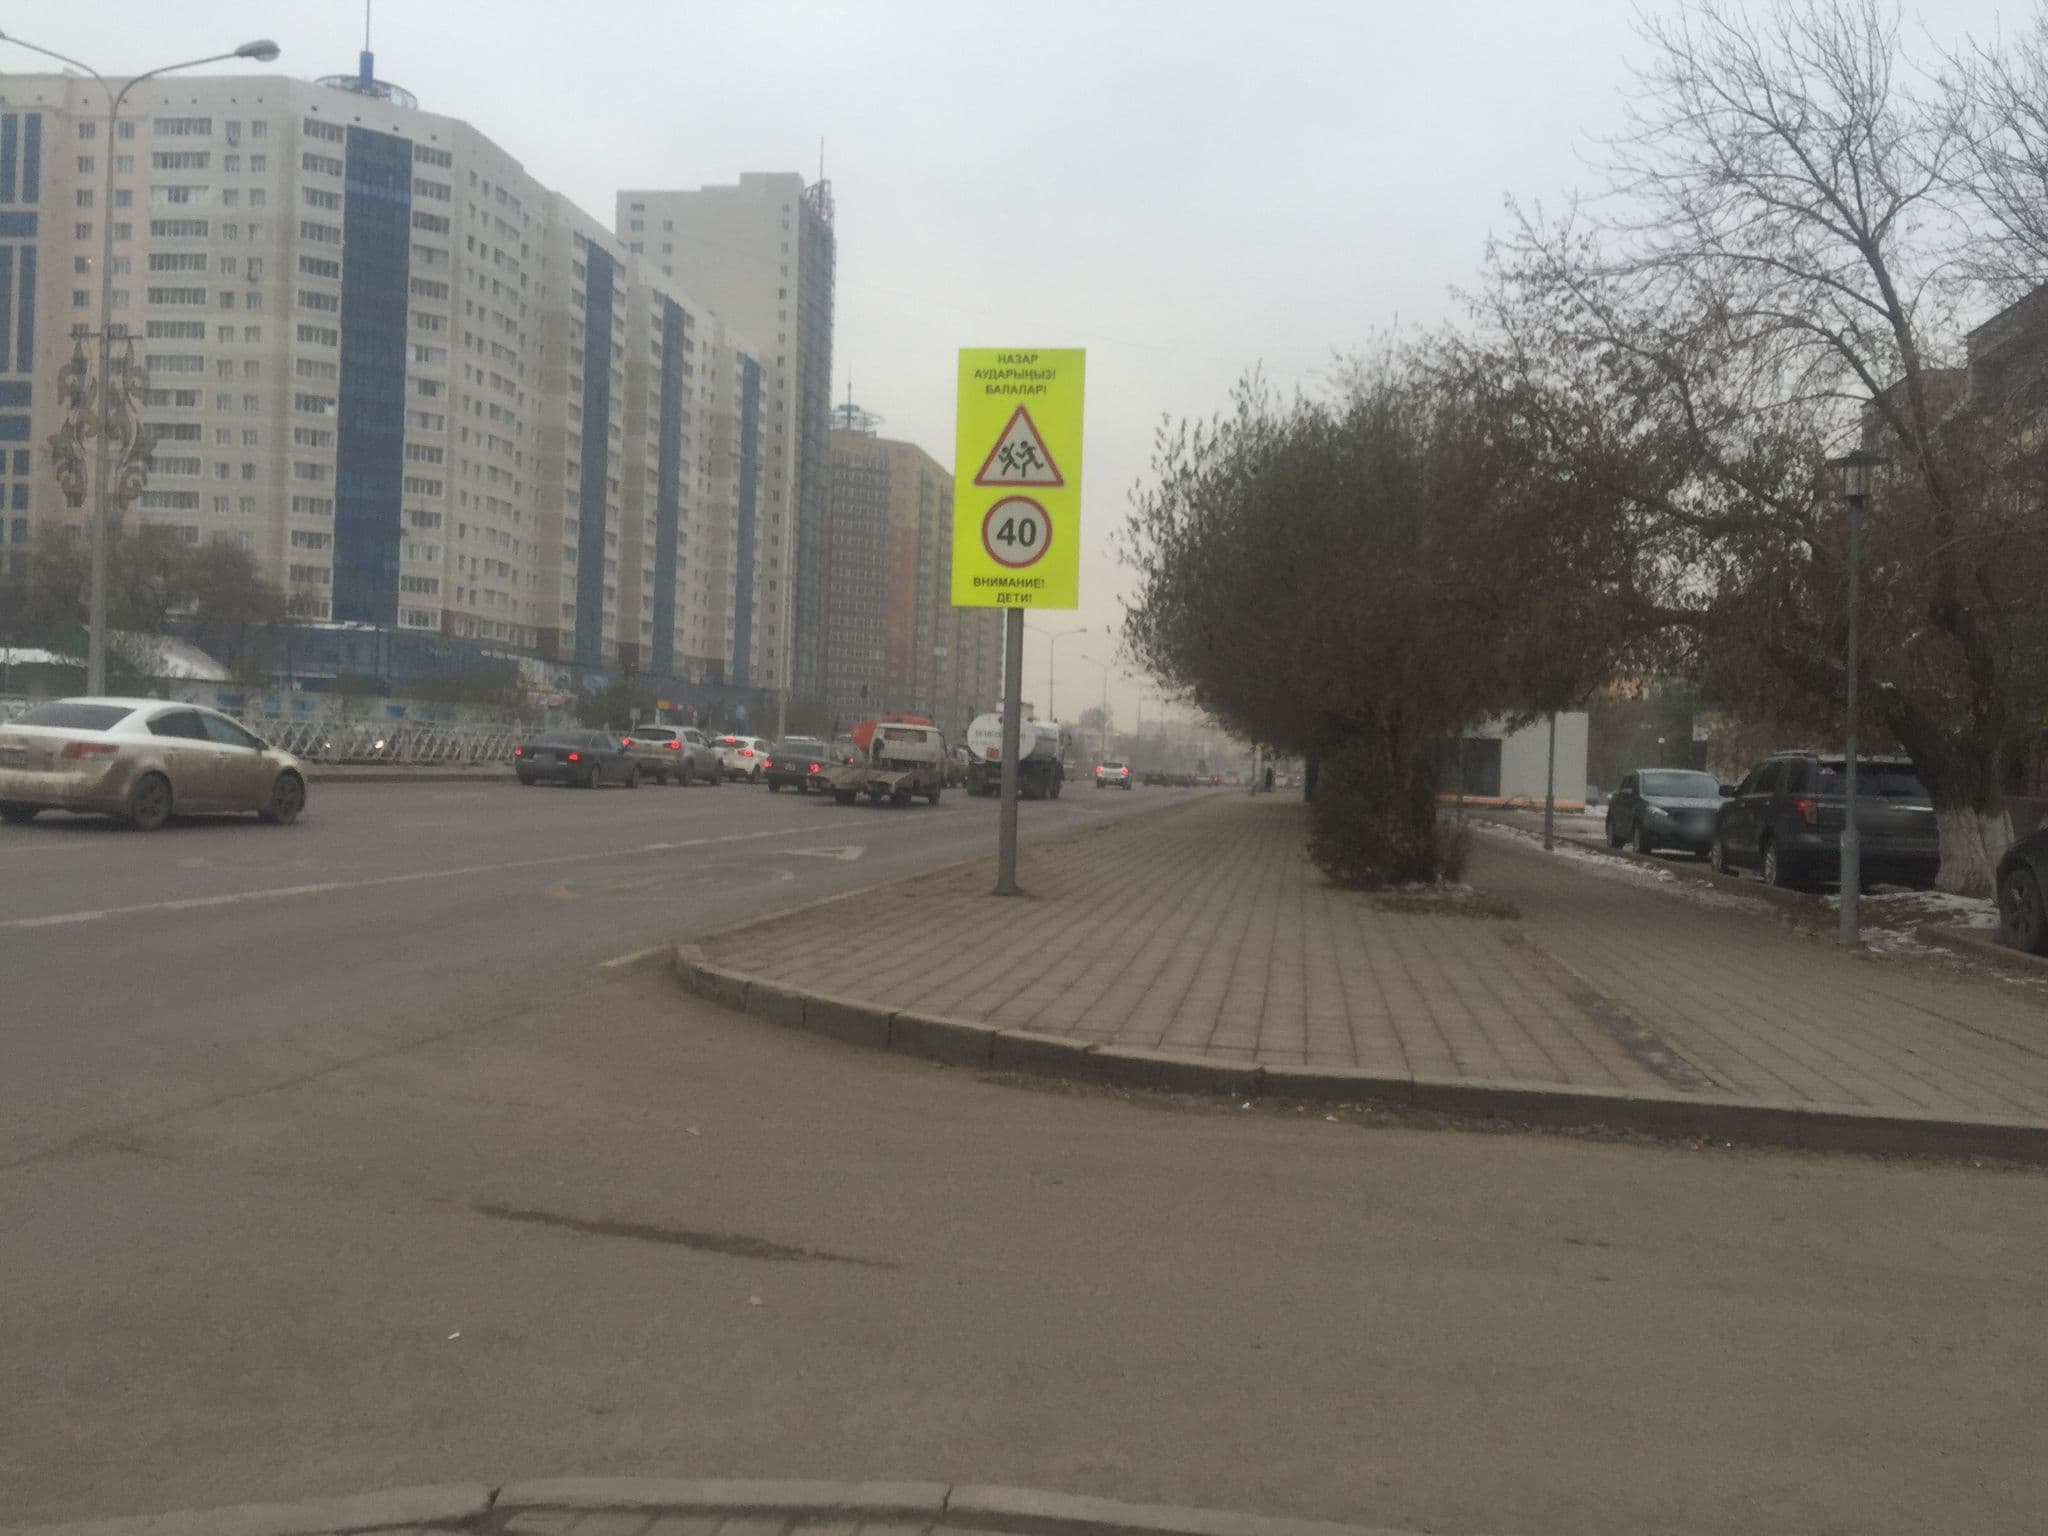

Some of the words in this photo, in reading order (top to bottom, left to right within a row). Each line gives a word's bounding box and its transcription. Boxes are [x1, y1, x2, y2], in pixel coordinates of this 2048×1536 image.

[998, 353, 1039, 364] НАЗАР
[985, 384, 1047, 395] БАЛАЛАР!
[996, 517, 1037, 547] 40
[973, 577, 1045, 589] ВНИМАНИЕ!
[996, 593, 1032, 604] ДЕТИ!
